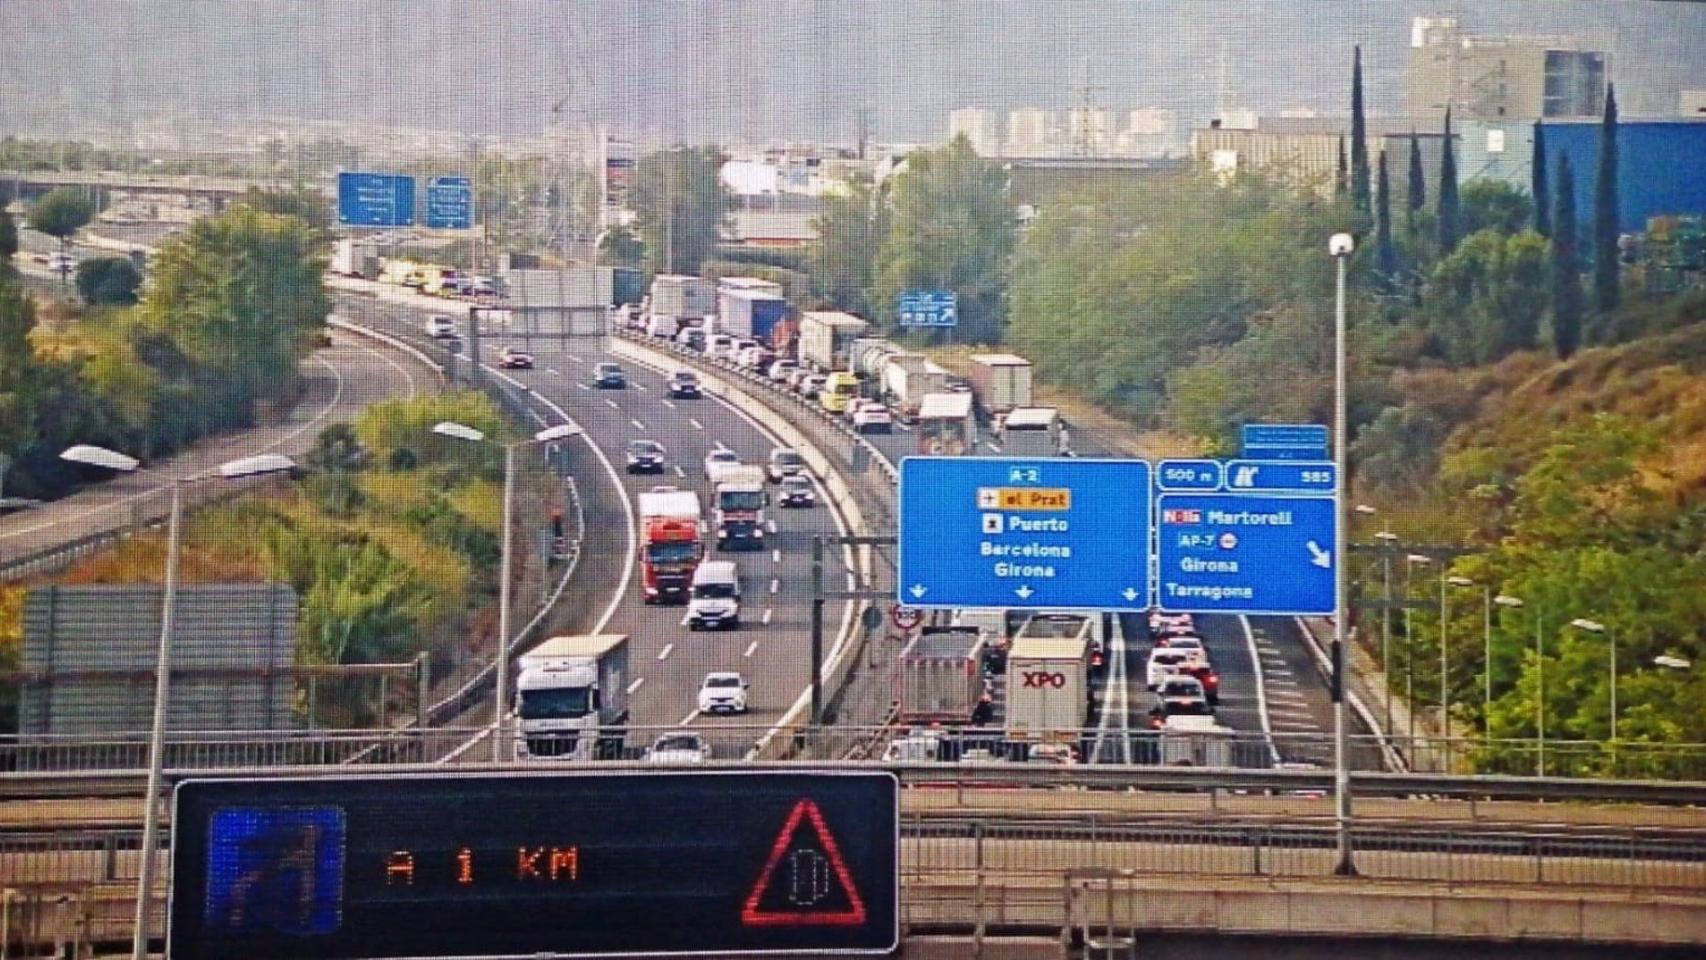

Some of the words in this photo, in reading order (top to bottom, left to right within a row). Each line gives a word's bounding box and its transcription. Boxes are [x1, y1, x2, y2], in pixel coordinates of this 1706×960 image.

[1011, 469, 1037, 481] A-2
[1166, 468, 1195, 481] 500
[1201, 471, 1212, 481] m
[1007, 492, 1022, 504] el
[1031, 492, 1065, 506] Prat
[1009, 516, 1068, 531] Puerto
[1207, 511, 1293, 525] Martorell
[1180, 535, 1215, 546] AP-7
[980, 541, 1071, 557] Barcelona
[994, 562, 1055, 577] Girona
[1181, 557, 1239, 573] Girona
[1166, 583, 1253, 599] Tarragona
[1022, 672, 1066, 689] XPO
[387, 850, 414, 885] A
[457, 848, 473, 882] 1
[518, 846, 578, 880] KM
